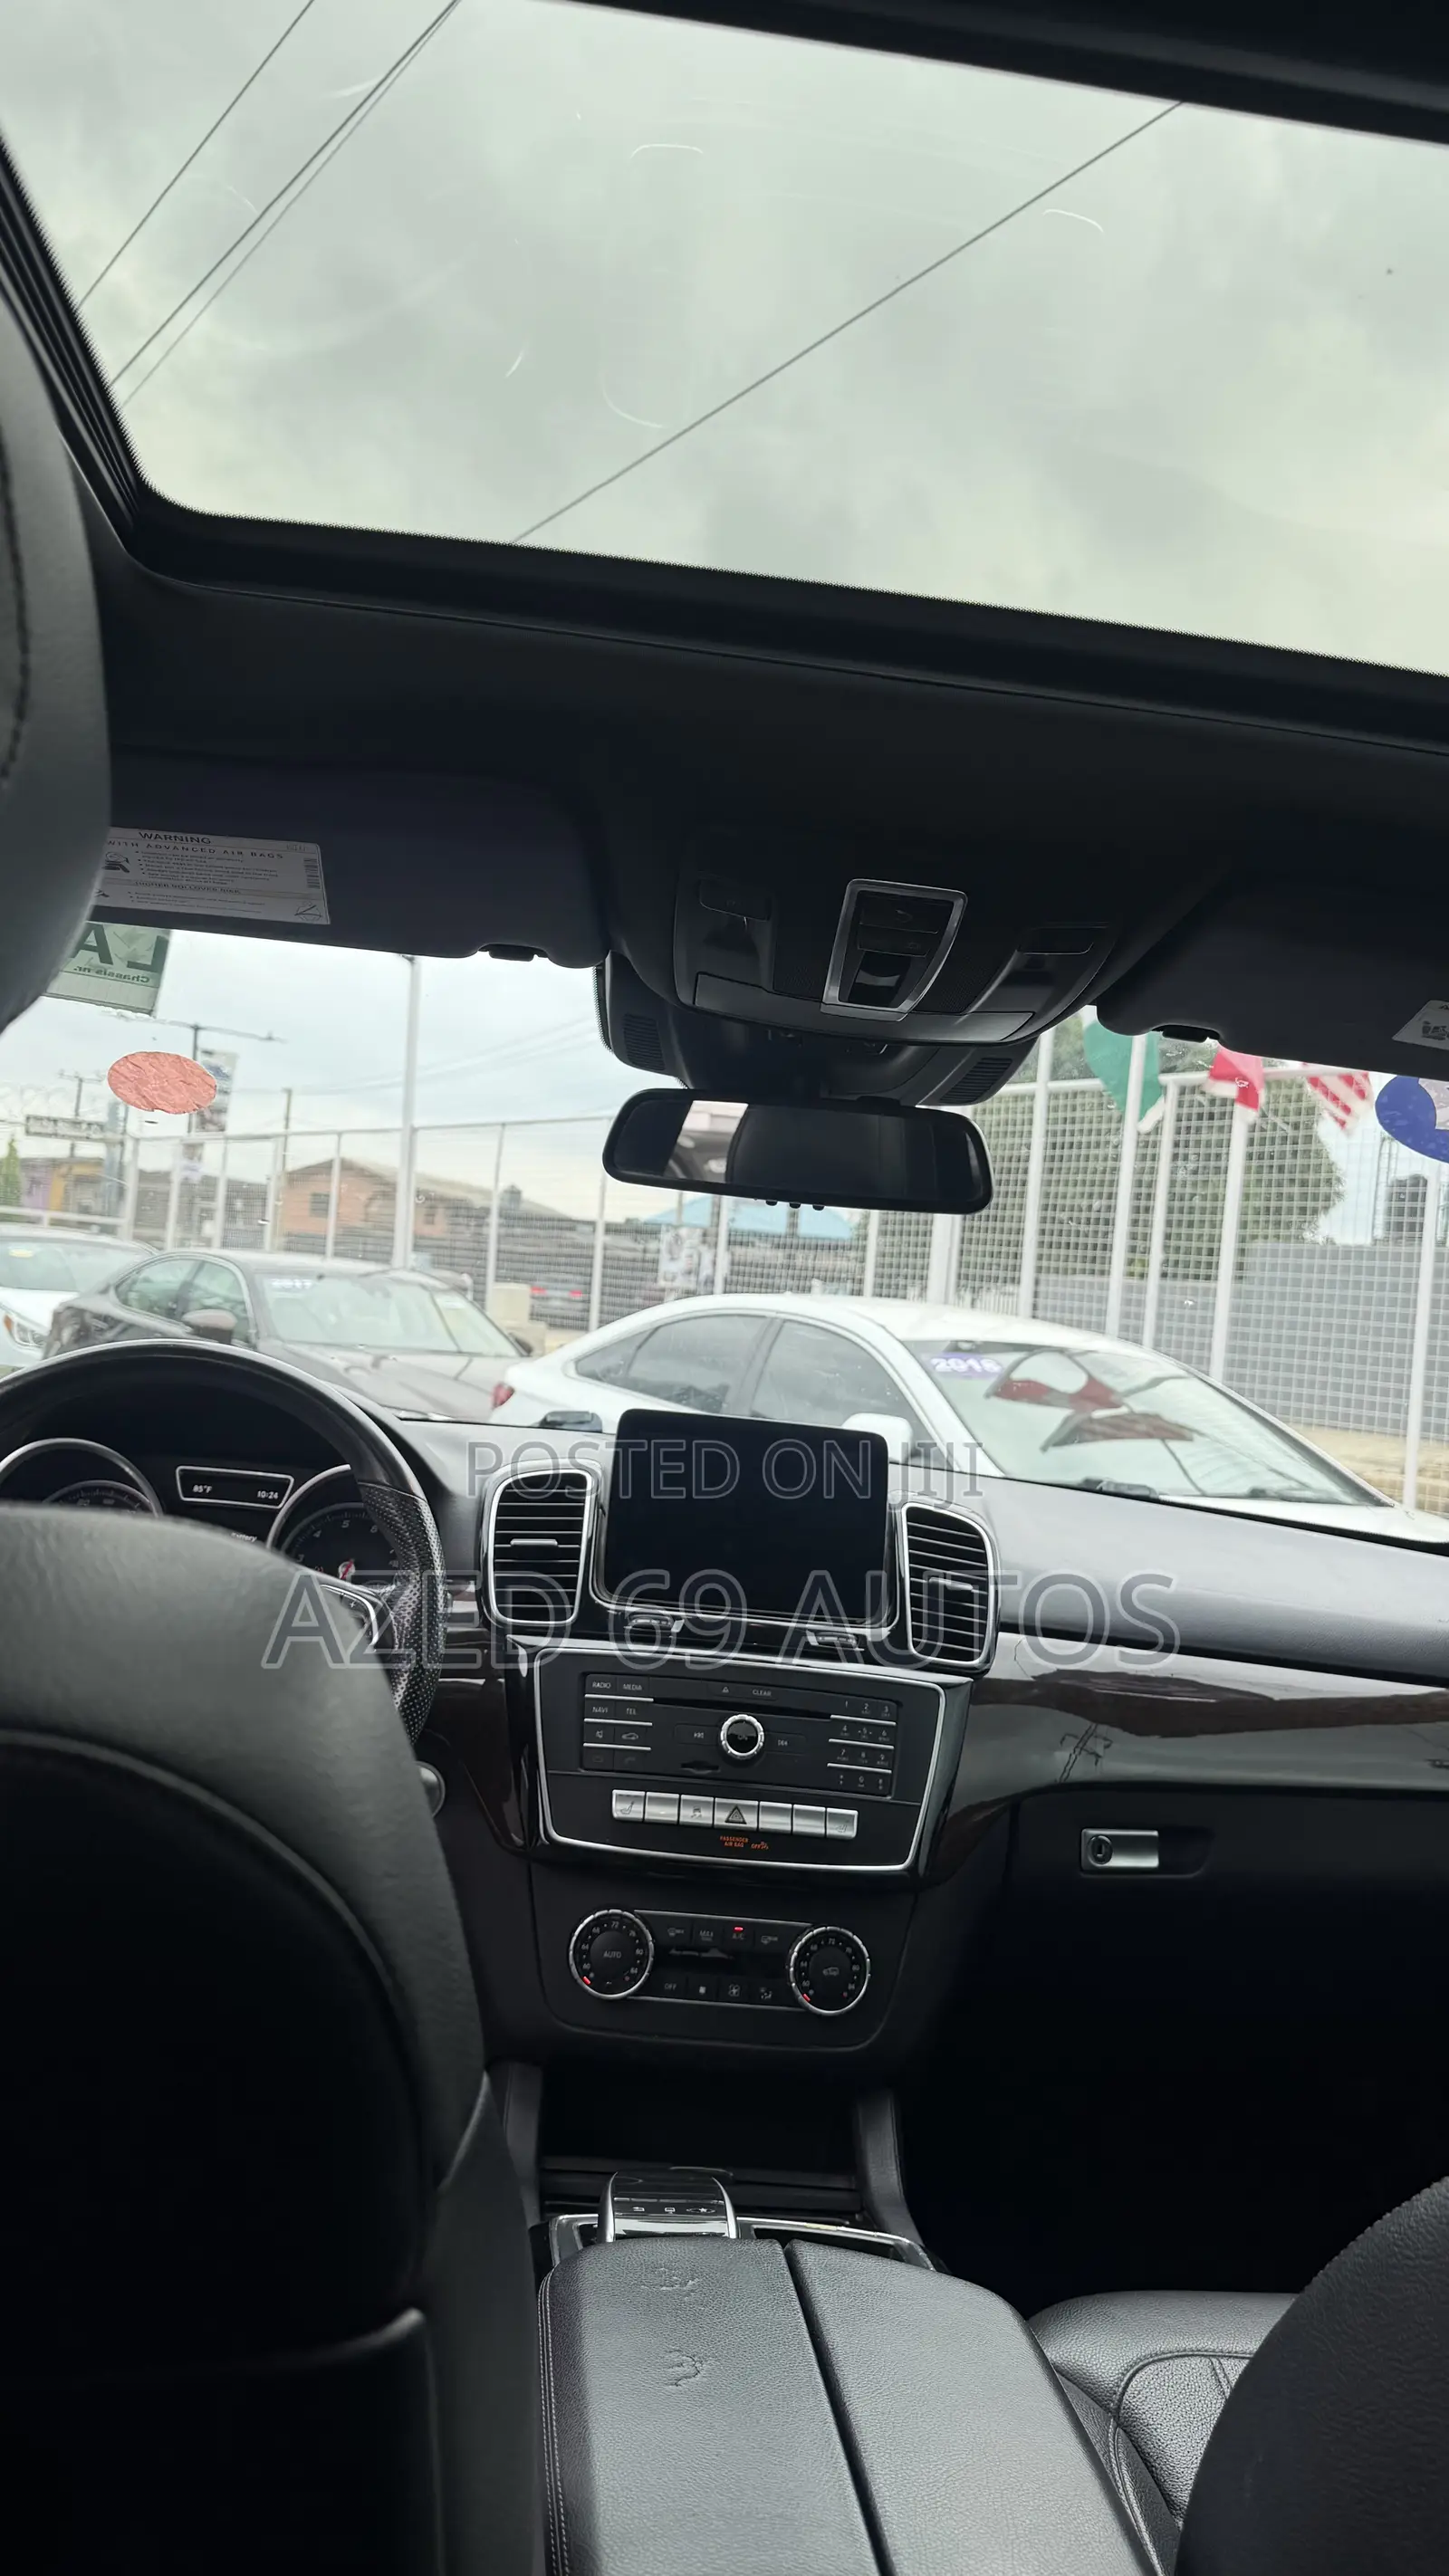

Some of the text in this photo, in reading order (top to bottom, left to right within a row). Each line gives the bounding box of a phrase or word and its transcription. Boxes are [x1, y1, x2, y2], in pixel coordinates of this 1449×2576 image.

[139, 831, 211, 844] WARNING
[146, 843, 216, 854] ADVANCED
[257, 1490, 278, 1499] 10:24
[591, 1681, 611, 1690] RADIO
[752, 1689, 772, 1697] CLEAR
[591, 1706, 609, 1714] NAVI
[626, 1707, 637, 1715] TEL
[603, 1950, 622, 1958] AUTO
